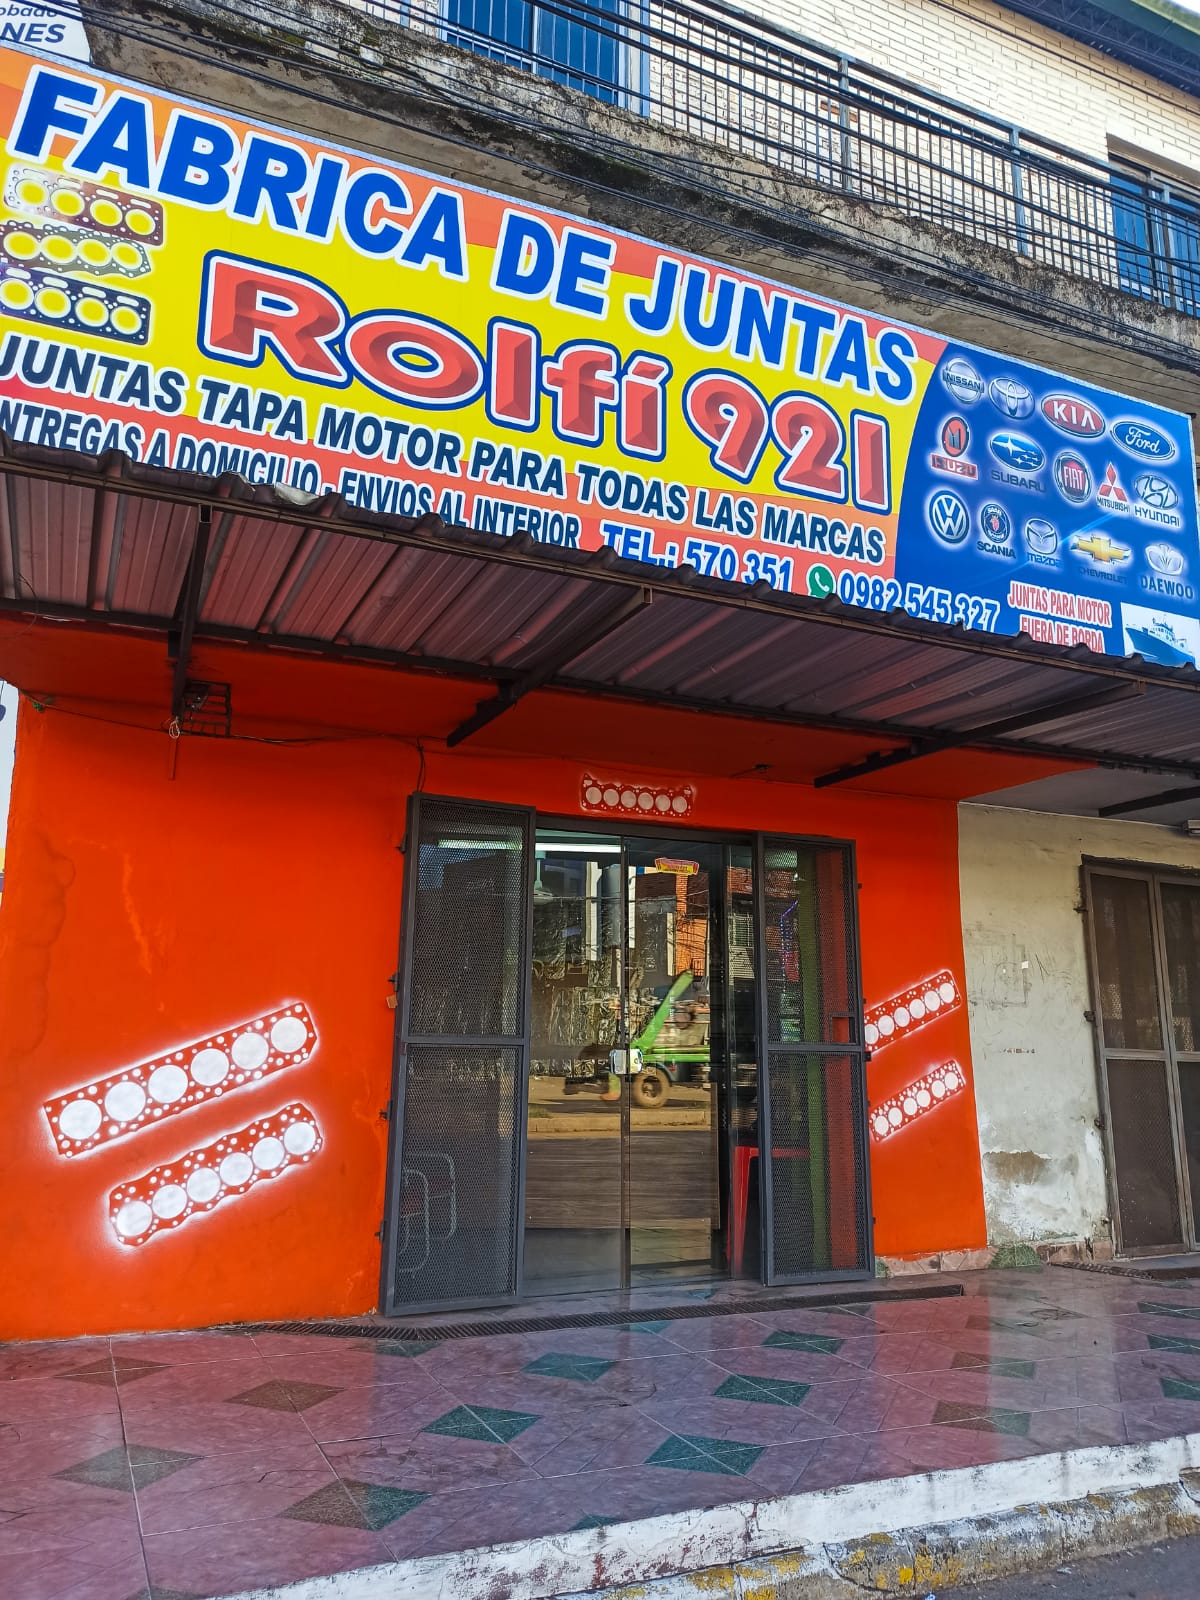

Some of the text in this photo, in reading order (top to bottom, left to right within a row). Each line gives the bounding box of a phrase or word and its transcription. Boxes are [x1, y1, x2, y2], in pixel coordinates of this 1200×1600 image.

[14, 68, 917, 402] FABRICA DE JUNTAS
[944, 372, 981, 392] NISSAN
[1053, 401, 1095, 430] KIA
[0, 334, 886, 564] JUNTAS TAPA MOTOR PARA TODAS LAS MARCAS
[684, 370, 890, 513] 921
[1125, 426, 1160, 454] Ford
[147, 431, 167, 468] A
[340, 470, 434, 518] ENVIOS
[438, 490, 468, 527] AL
[474, 498, 581, 549] INTERIOR
[991, 469, 1047, 493] SUBARU
[1063, 466, 1084, 491] FIAT
[1097, 496, 1130, 512] MITSUBISHI
[1134, 505, 1180, 527] HYUNDAI
[976, 540, 1017, 559] SCANIA
[684, 540, 738, 583] 570
[743, 552, 792, 594] 351
[840, 572, 900, 613] 0982
[906, 585, 950, 624] 545
[953, 595, 1000, 634] 327
[1079, 566, 1128, 584] CHEVROLET
[1140, 575, 1193, 600] DAEWOO
[1008, 582, 1112, 627] JUNTAS PARA MOTOR
[1020, 615, 1055, 645] FUERA
[1055, 622, 1071, 648] DE
